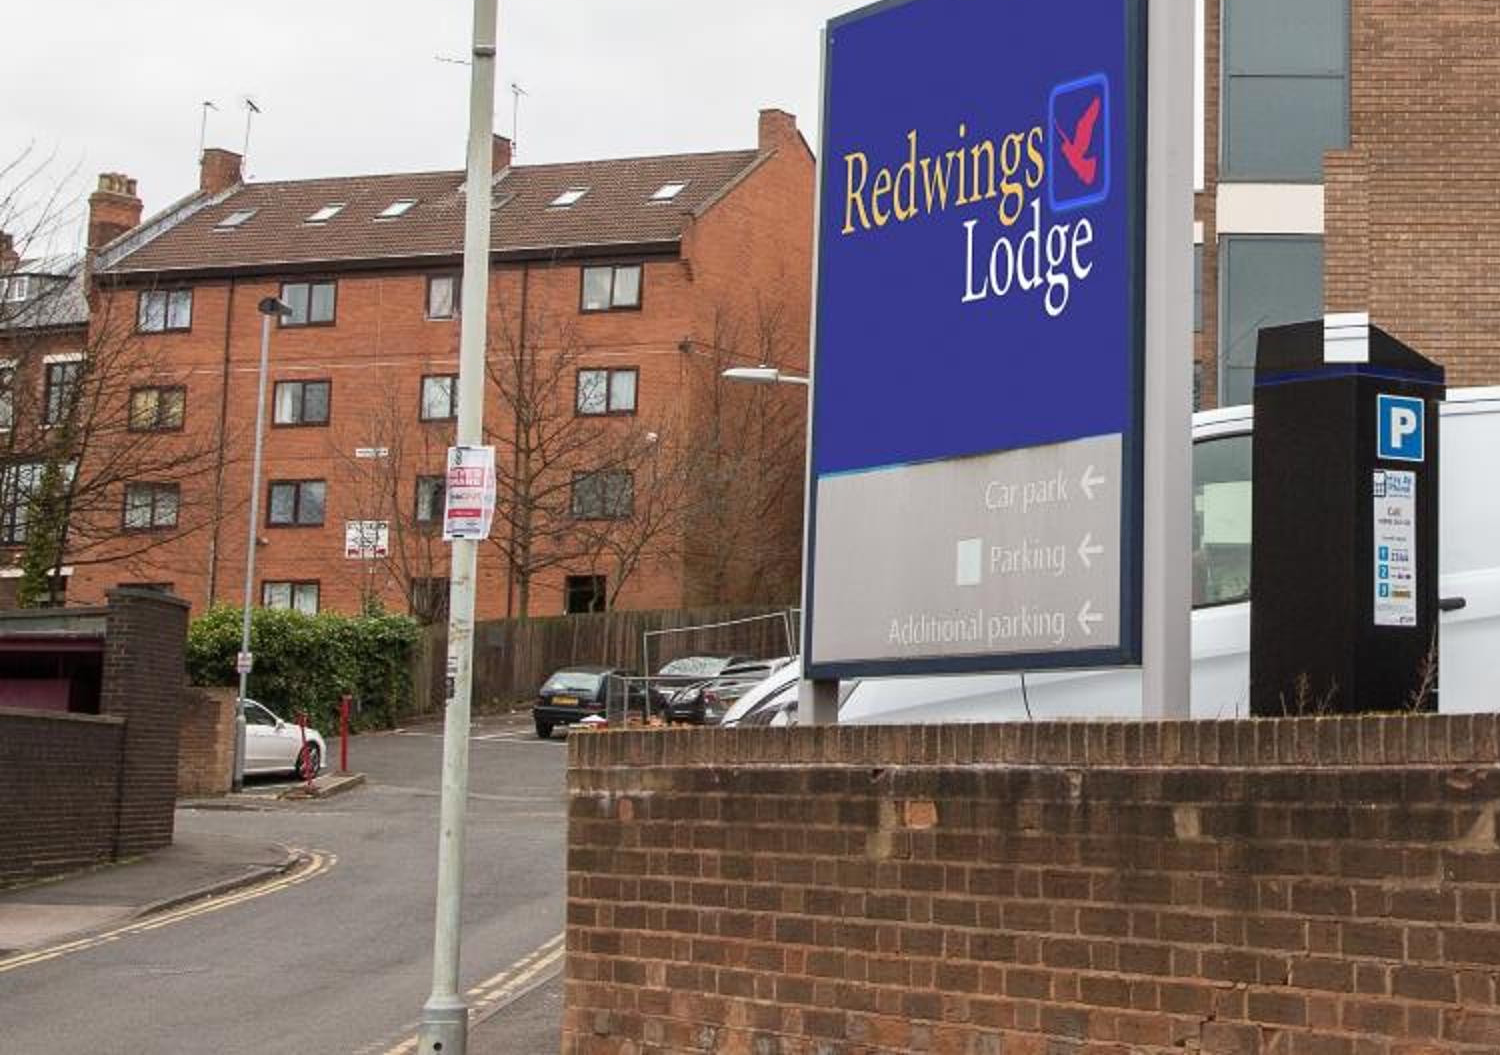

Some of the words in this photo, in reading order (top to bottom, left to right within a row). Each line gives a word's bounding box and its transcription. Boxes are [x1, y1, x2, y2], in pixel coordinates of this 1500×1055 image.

[841, 123, 1045, 235] Redwings
[961, 197, 1094, 317] Lodge
[1391, 407, 1417, 449] P
[984, 479, 1018, 509] Car
[1022, 470, 1068, 513] park
[990, 538, 1066, 576] Parking
[888, 609, 983, 645] Additional
[987, 607, 1066, 645] parking
